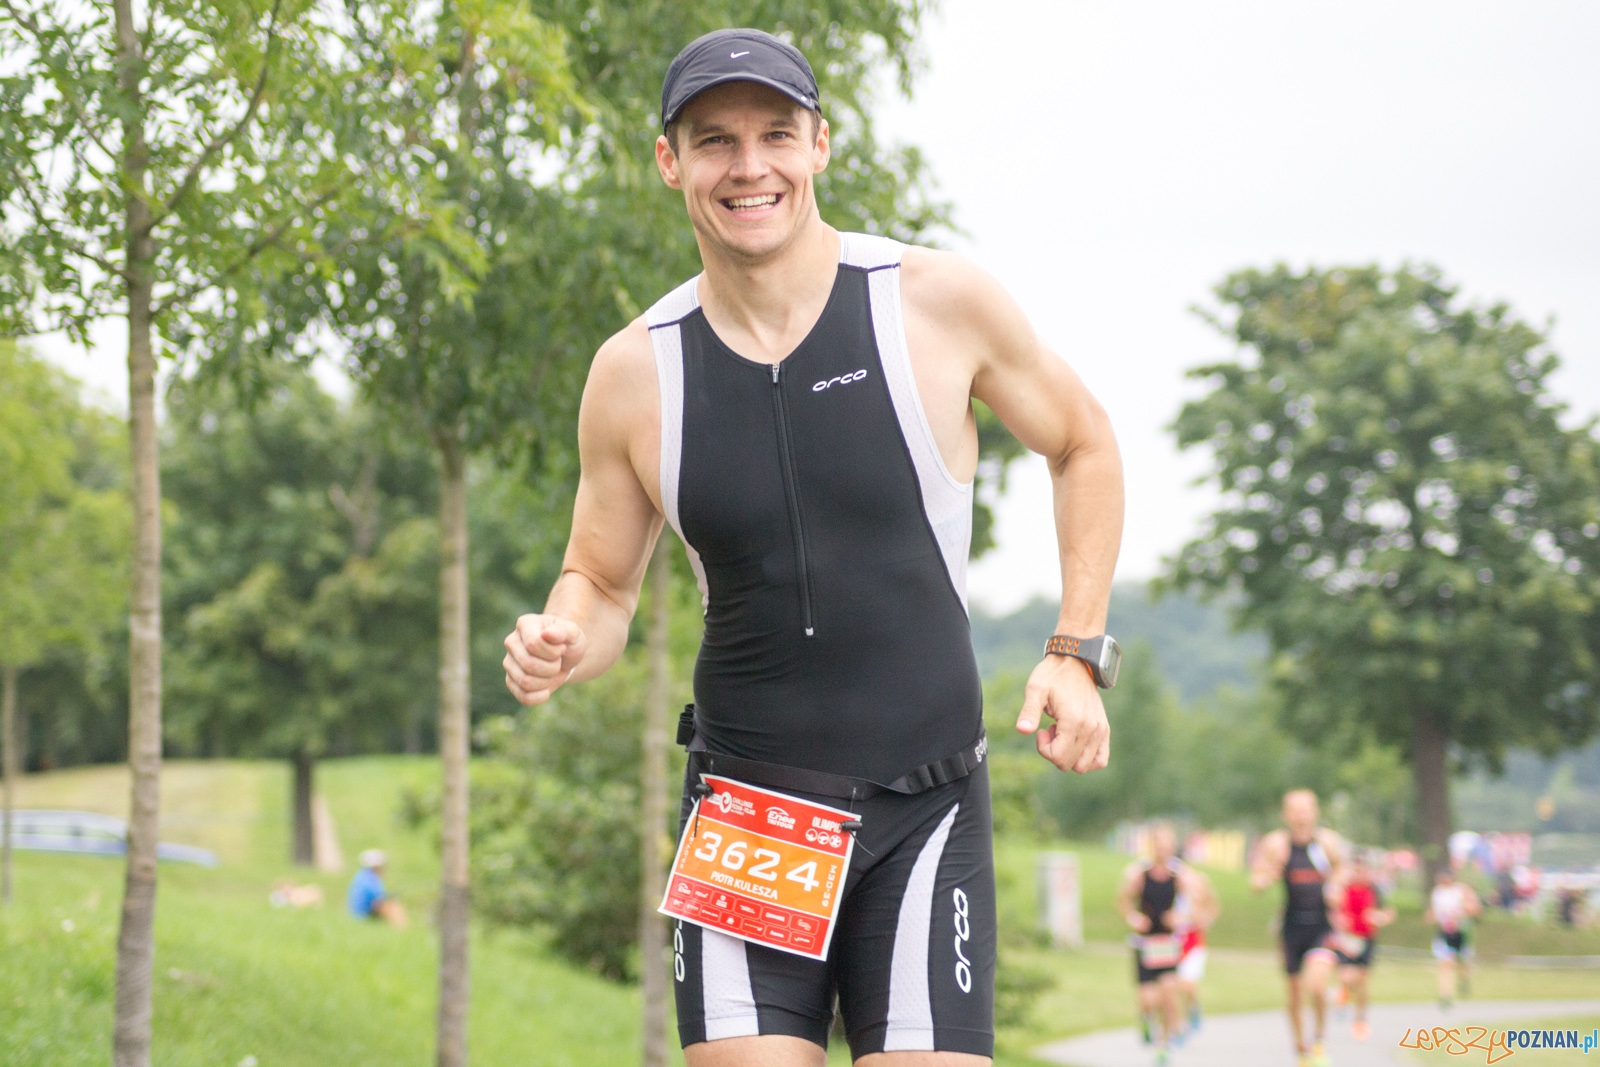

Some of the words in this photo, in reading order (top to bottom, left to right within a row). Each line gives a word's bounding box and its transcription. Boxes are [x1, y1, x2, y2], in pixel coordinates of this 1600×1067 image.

[812, 369, 868, 392] orca
[694, 831, 820, 892] 3624
[710, 870, 735, 887] PIOTR
[733, 878, 779, 900] KULESZA
[953, 887, 972, 994] orca
